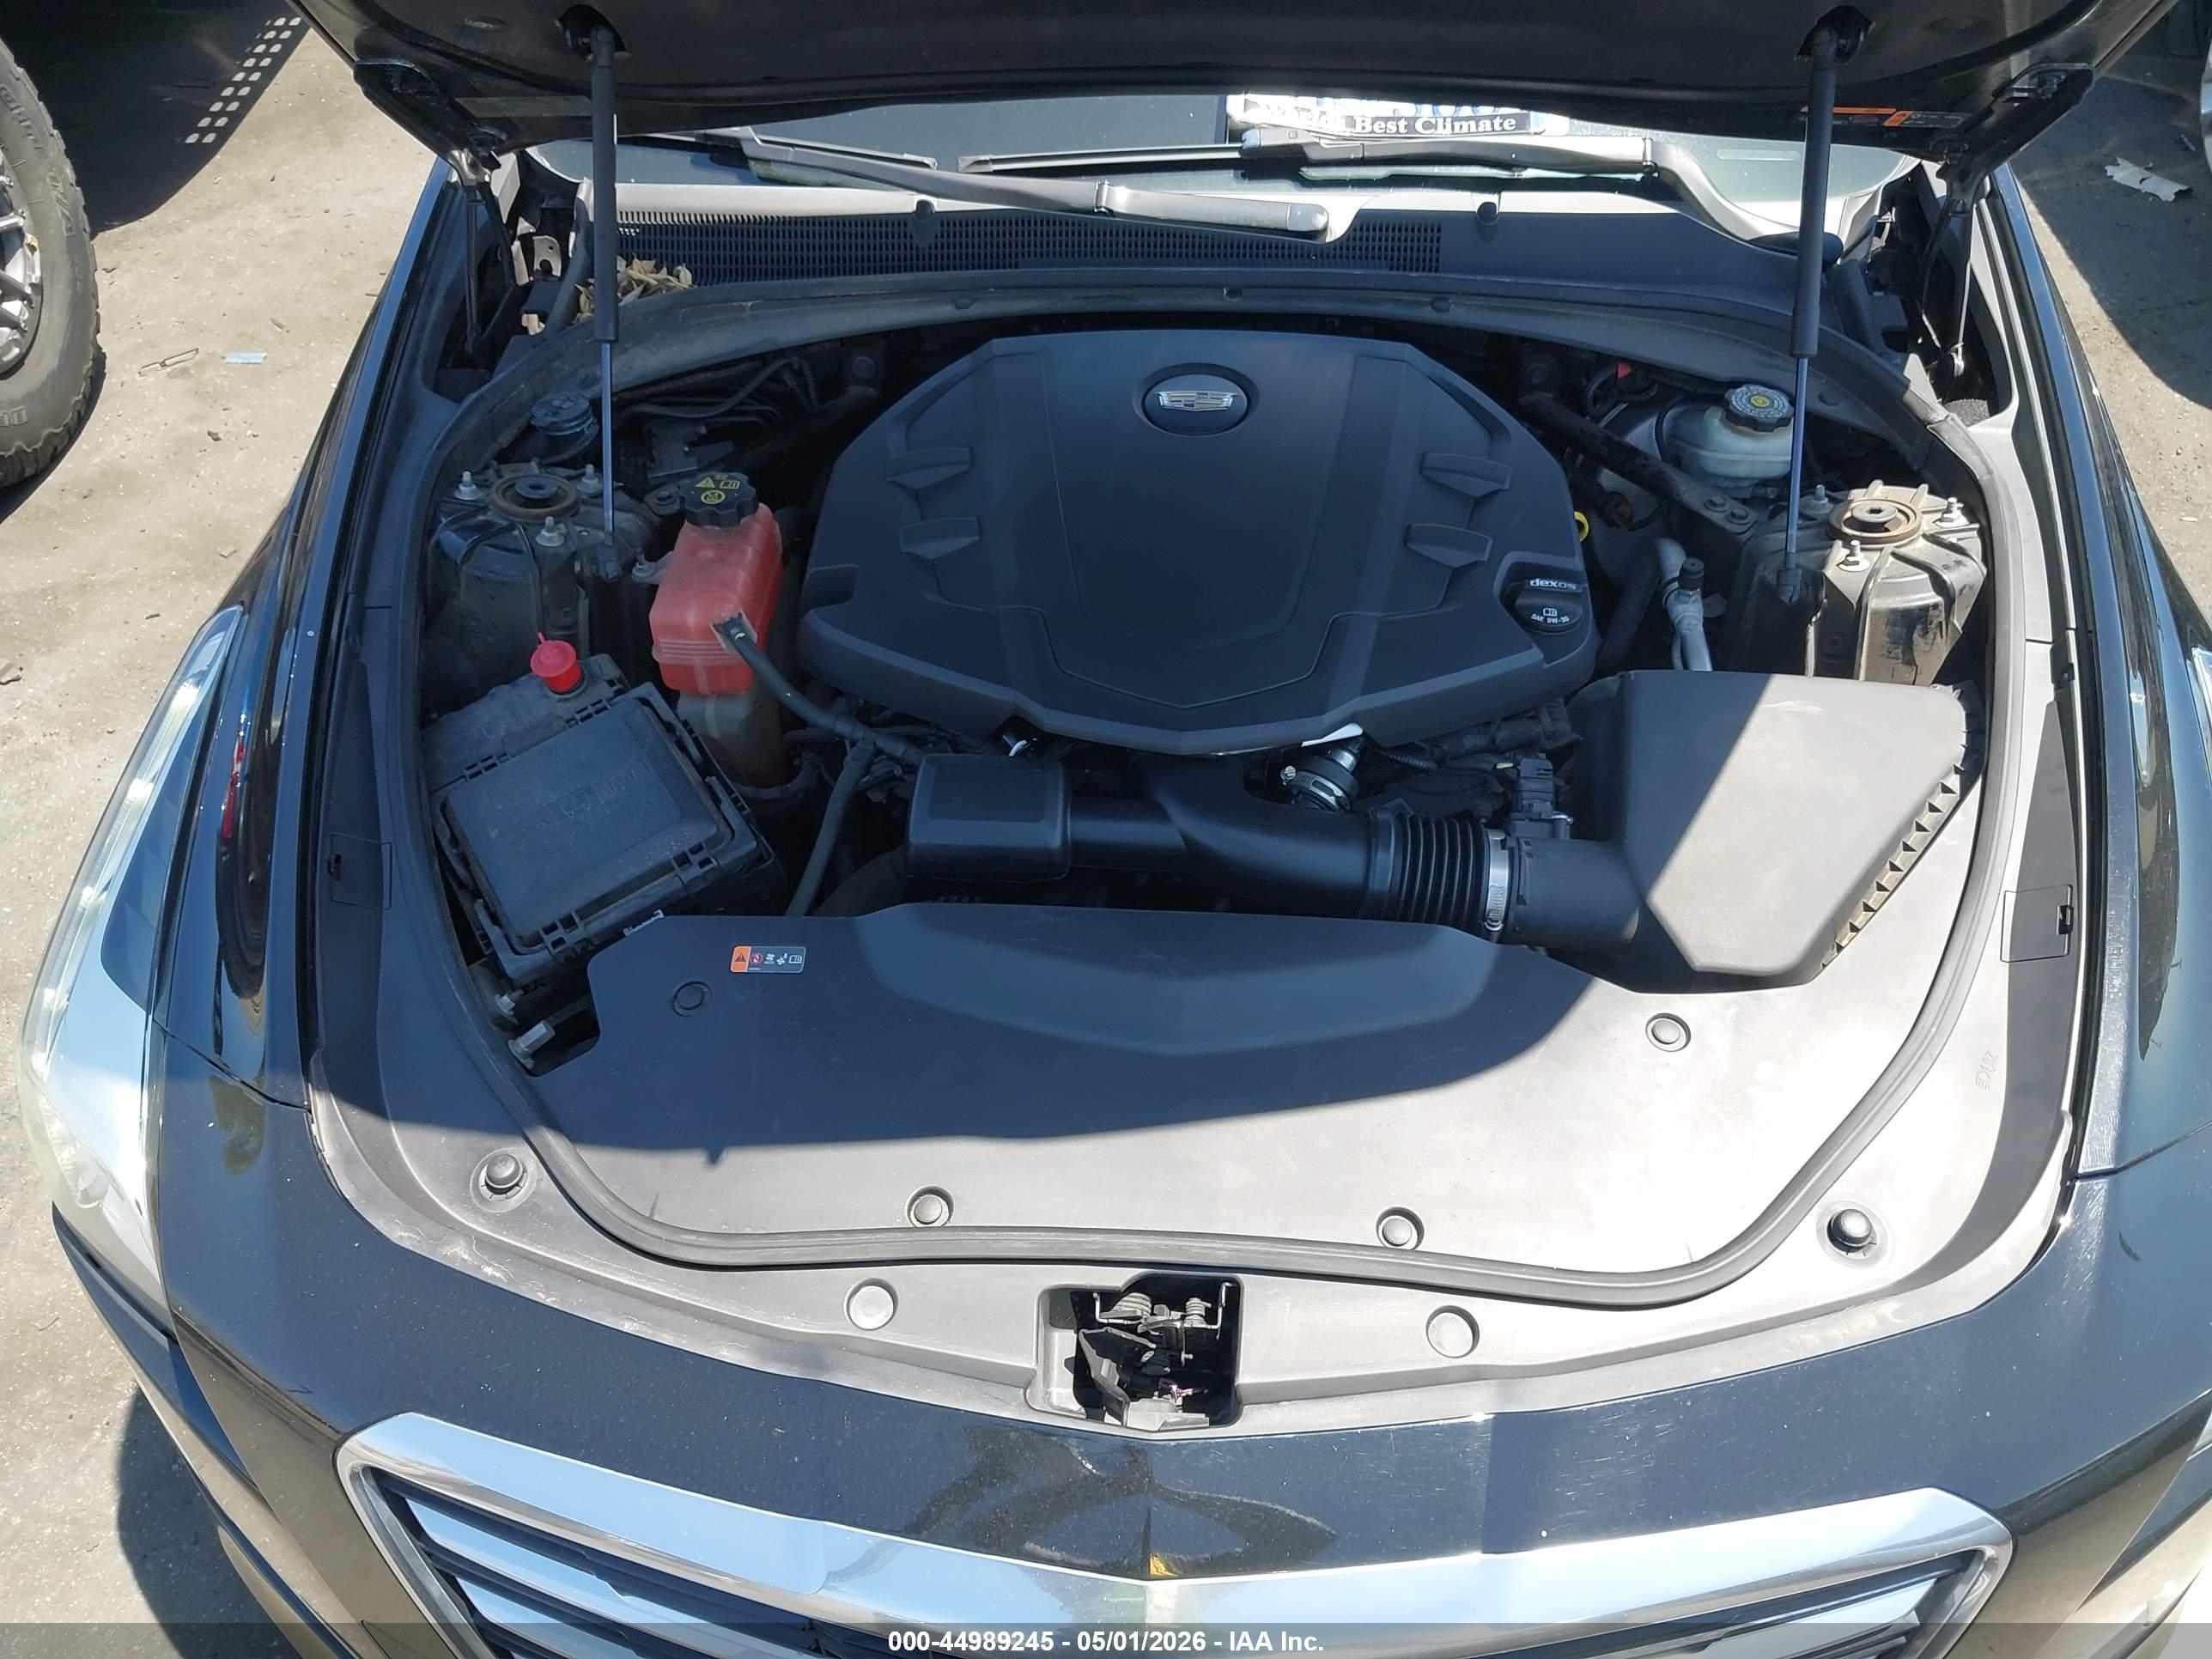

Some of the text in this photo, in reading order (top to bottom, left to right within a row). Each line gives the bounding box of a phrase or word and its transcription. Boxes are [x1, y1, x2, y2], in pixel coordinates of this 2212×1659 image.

[1353, 114, 1517, 136] Best Climate
[1529, 578, 1577, 590] dexos
